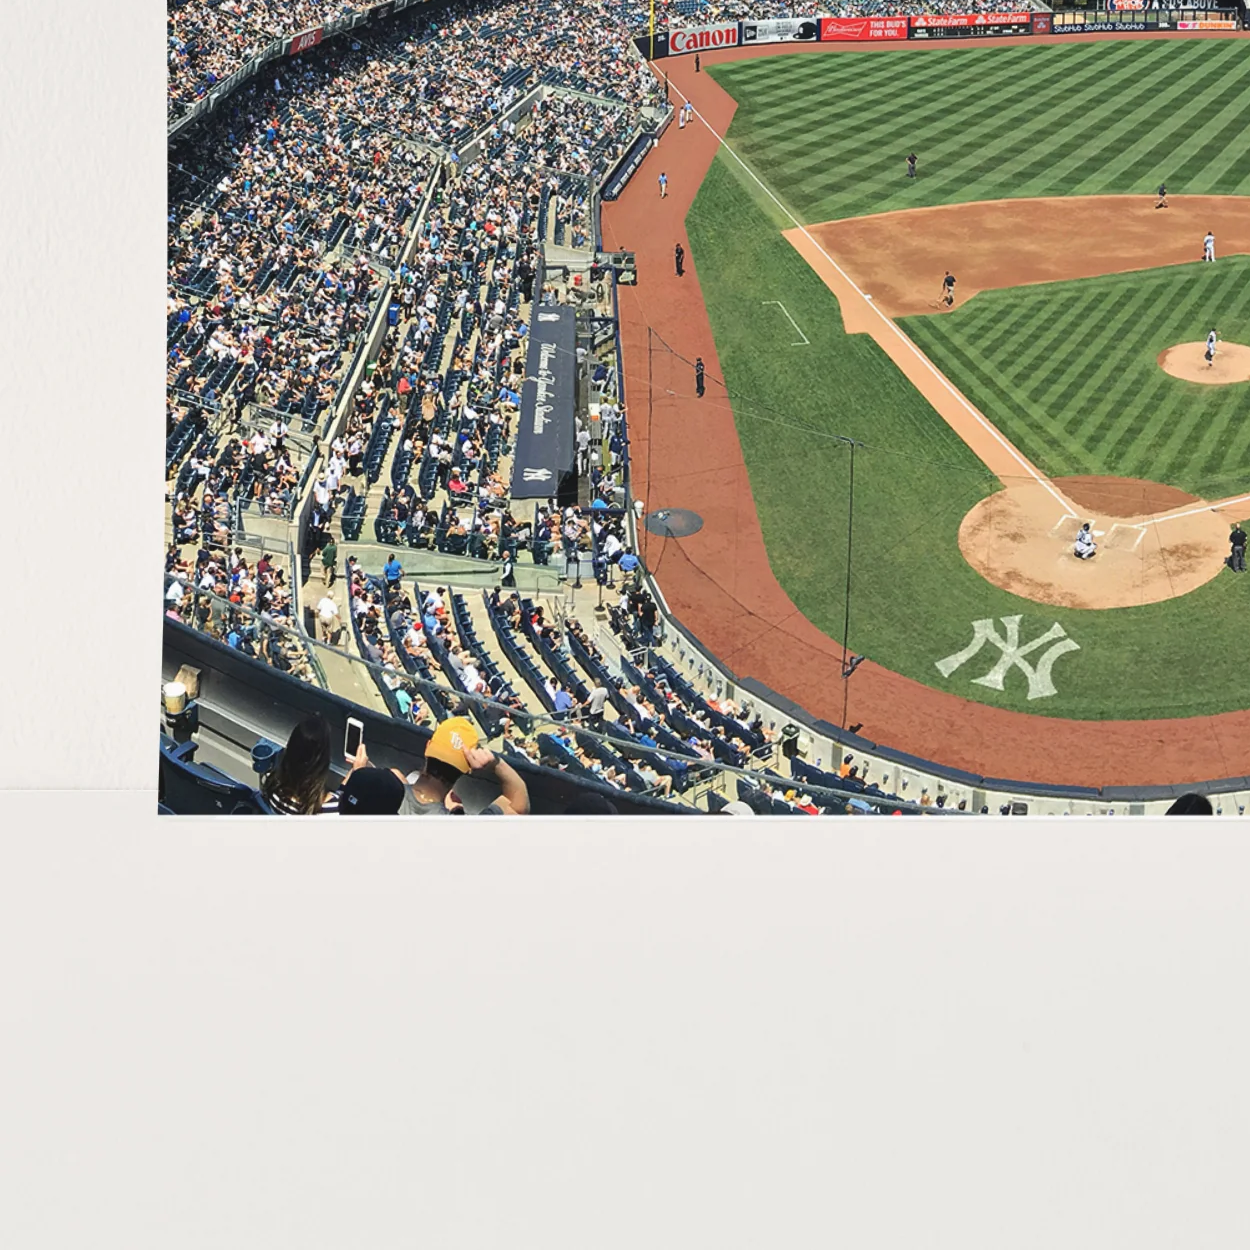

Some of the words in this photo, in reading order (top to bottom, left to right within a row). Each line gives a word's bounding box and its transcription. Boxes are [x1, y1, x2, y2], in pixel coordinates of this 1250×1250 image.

[886, 20, 907, 28] BUD'S
[927, 16, 968, 26] StateFarm
[987, 14, 1027, 24] StateFarm
[1054, 24, 1082, 33] StubHub
[1084, 22, 1113, 31] StubHub
[1115, 21, 1145, 30] StubHub
[298, 31, 316, 50] AVIS
[670, 27, 738, 53] Canon
